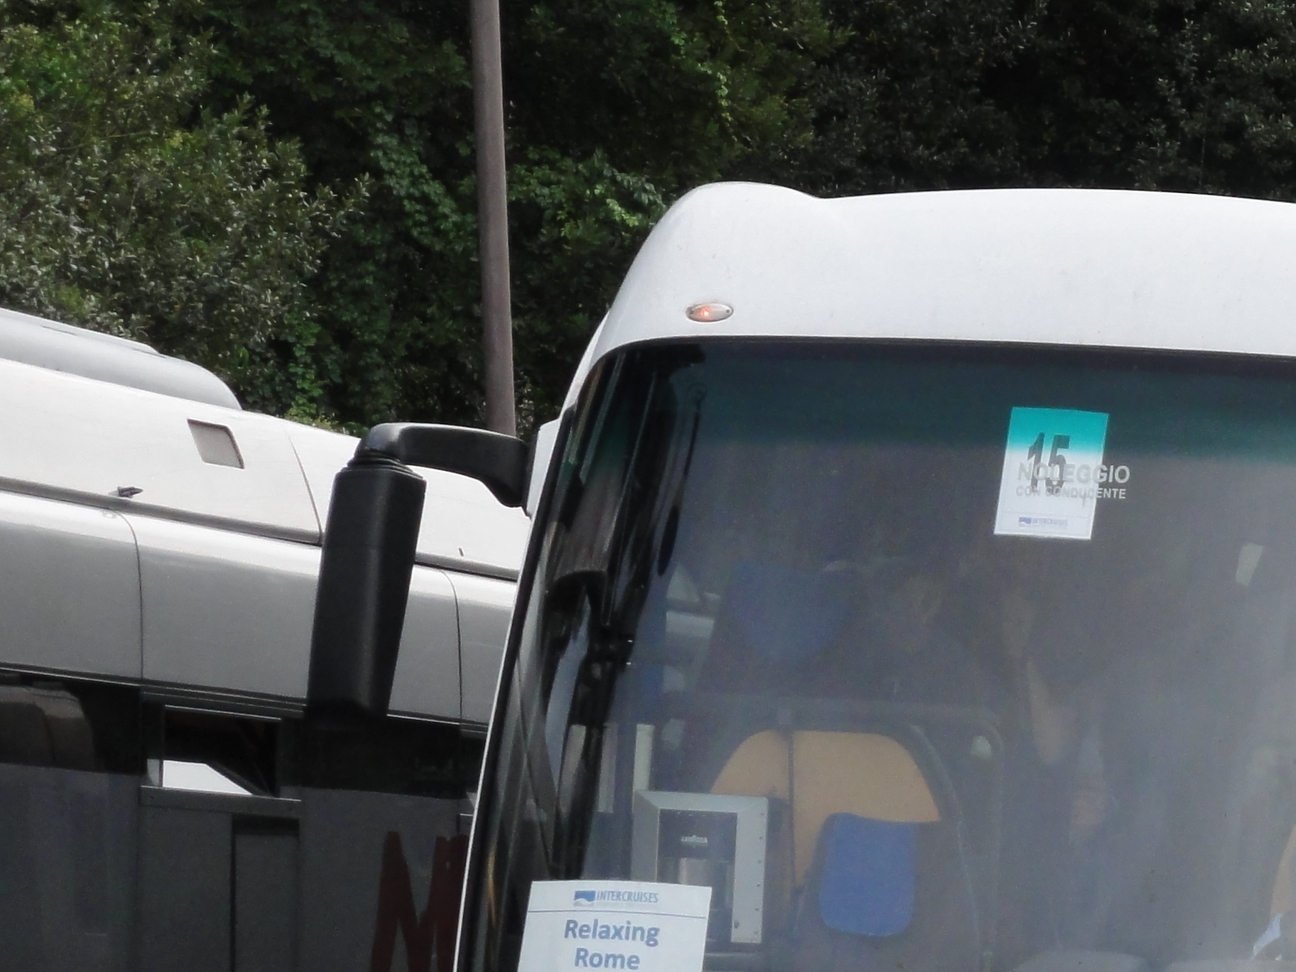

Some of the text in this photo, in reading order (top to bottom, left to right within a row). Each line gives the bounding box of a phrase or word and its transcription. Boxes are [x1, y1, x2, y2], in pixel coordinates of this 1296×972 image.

[1017, 461, 1131, 485] NOLEGGIO
[1027, 431, 1071, 495] 15
[1015, 484, 1127, 500] CON CONDUCENTE
[596, 890, 659, 904] INTERCRUISES
[563, 918, 661, 947] Relaxing
[574, 947, 641, 971] Rome
